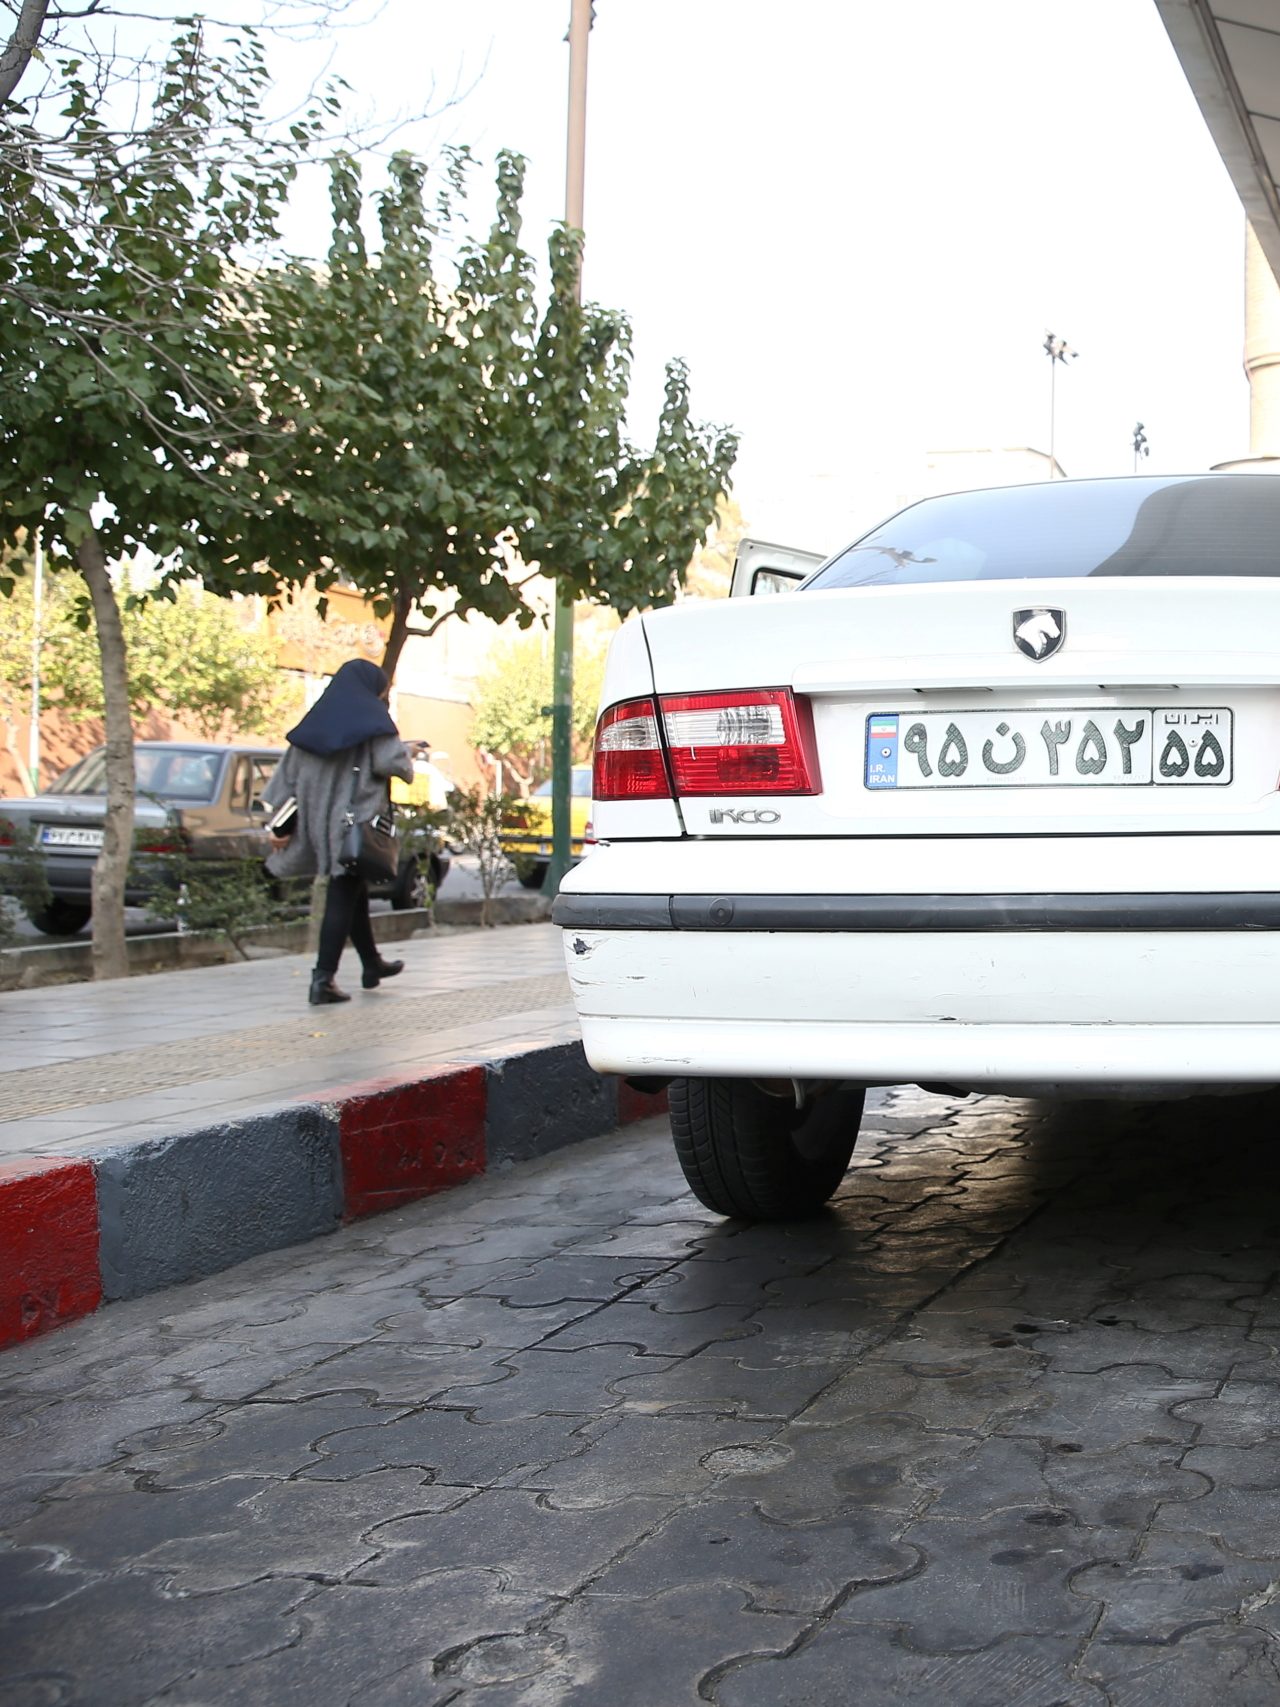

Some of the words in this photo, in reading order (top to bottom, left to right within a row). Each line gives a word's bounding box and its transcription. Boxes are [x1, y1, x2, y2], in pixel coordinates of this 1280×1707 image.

[1164, 713, 1219, 725] ایران
[1159, 729, 1225, 778] ۵۵
[869, 764, 886, 773] I.R.
[869, 775, 895, 783] IRAN
